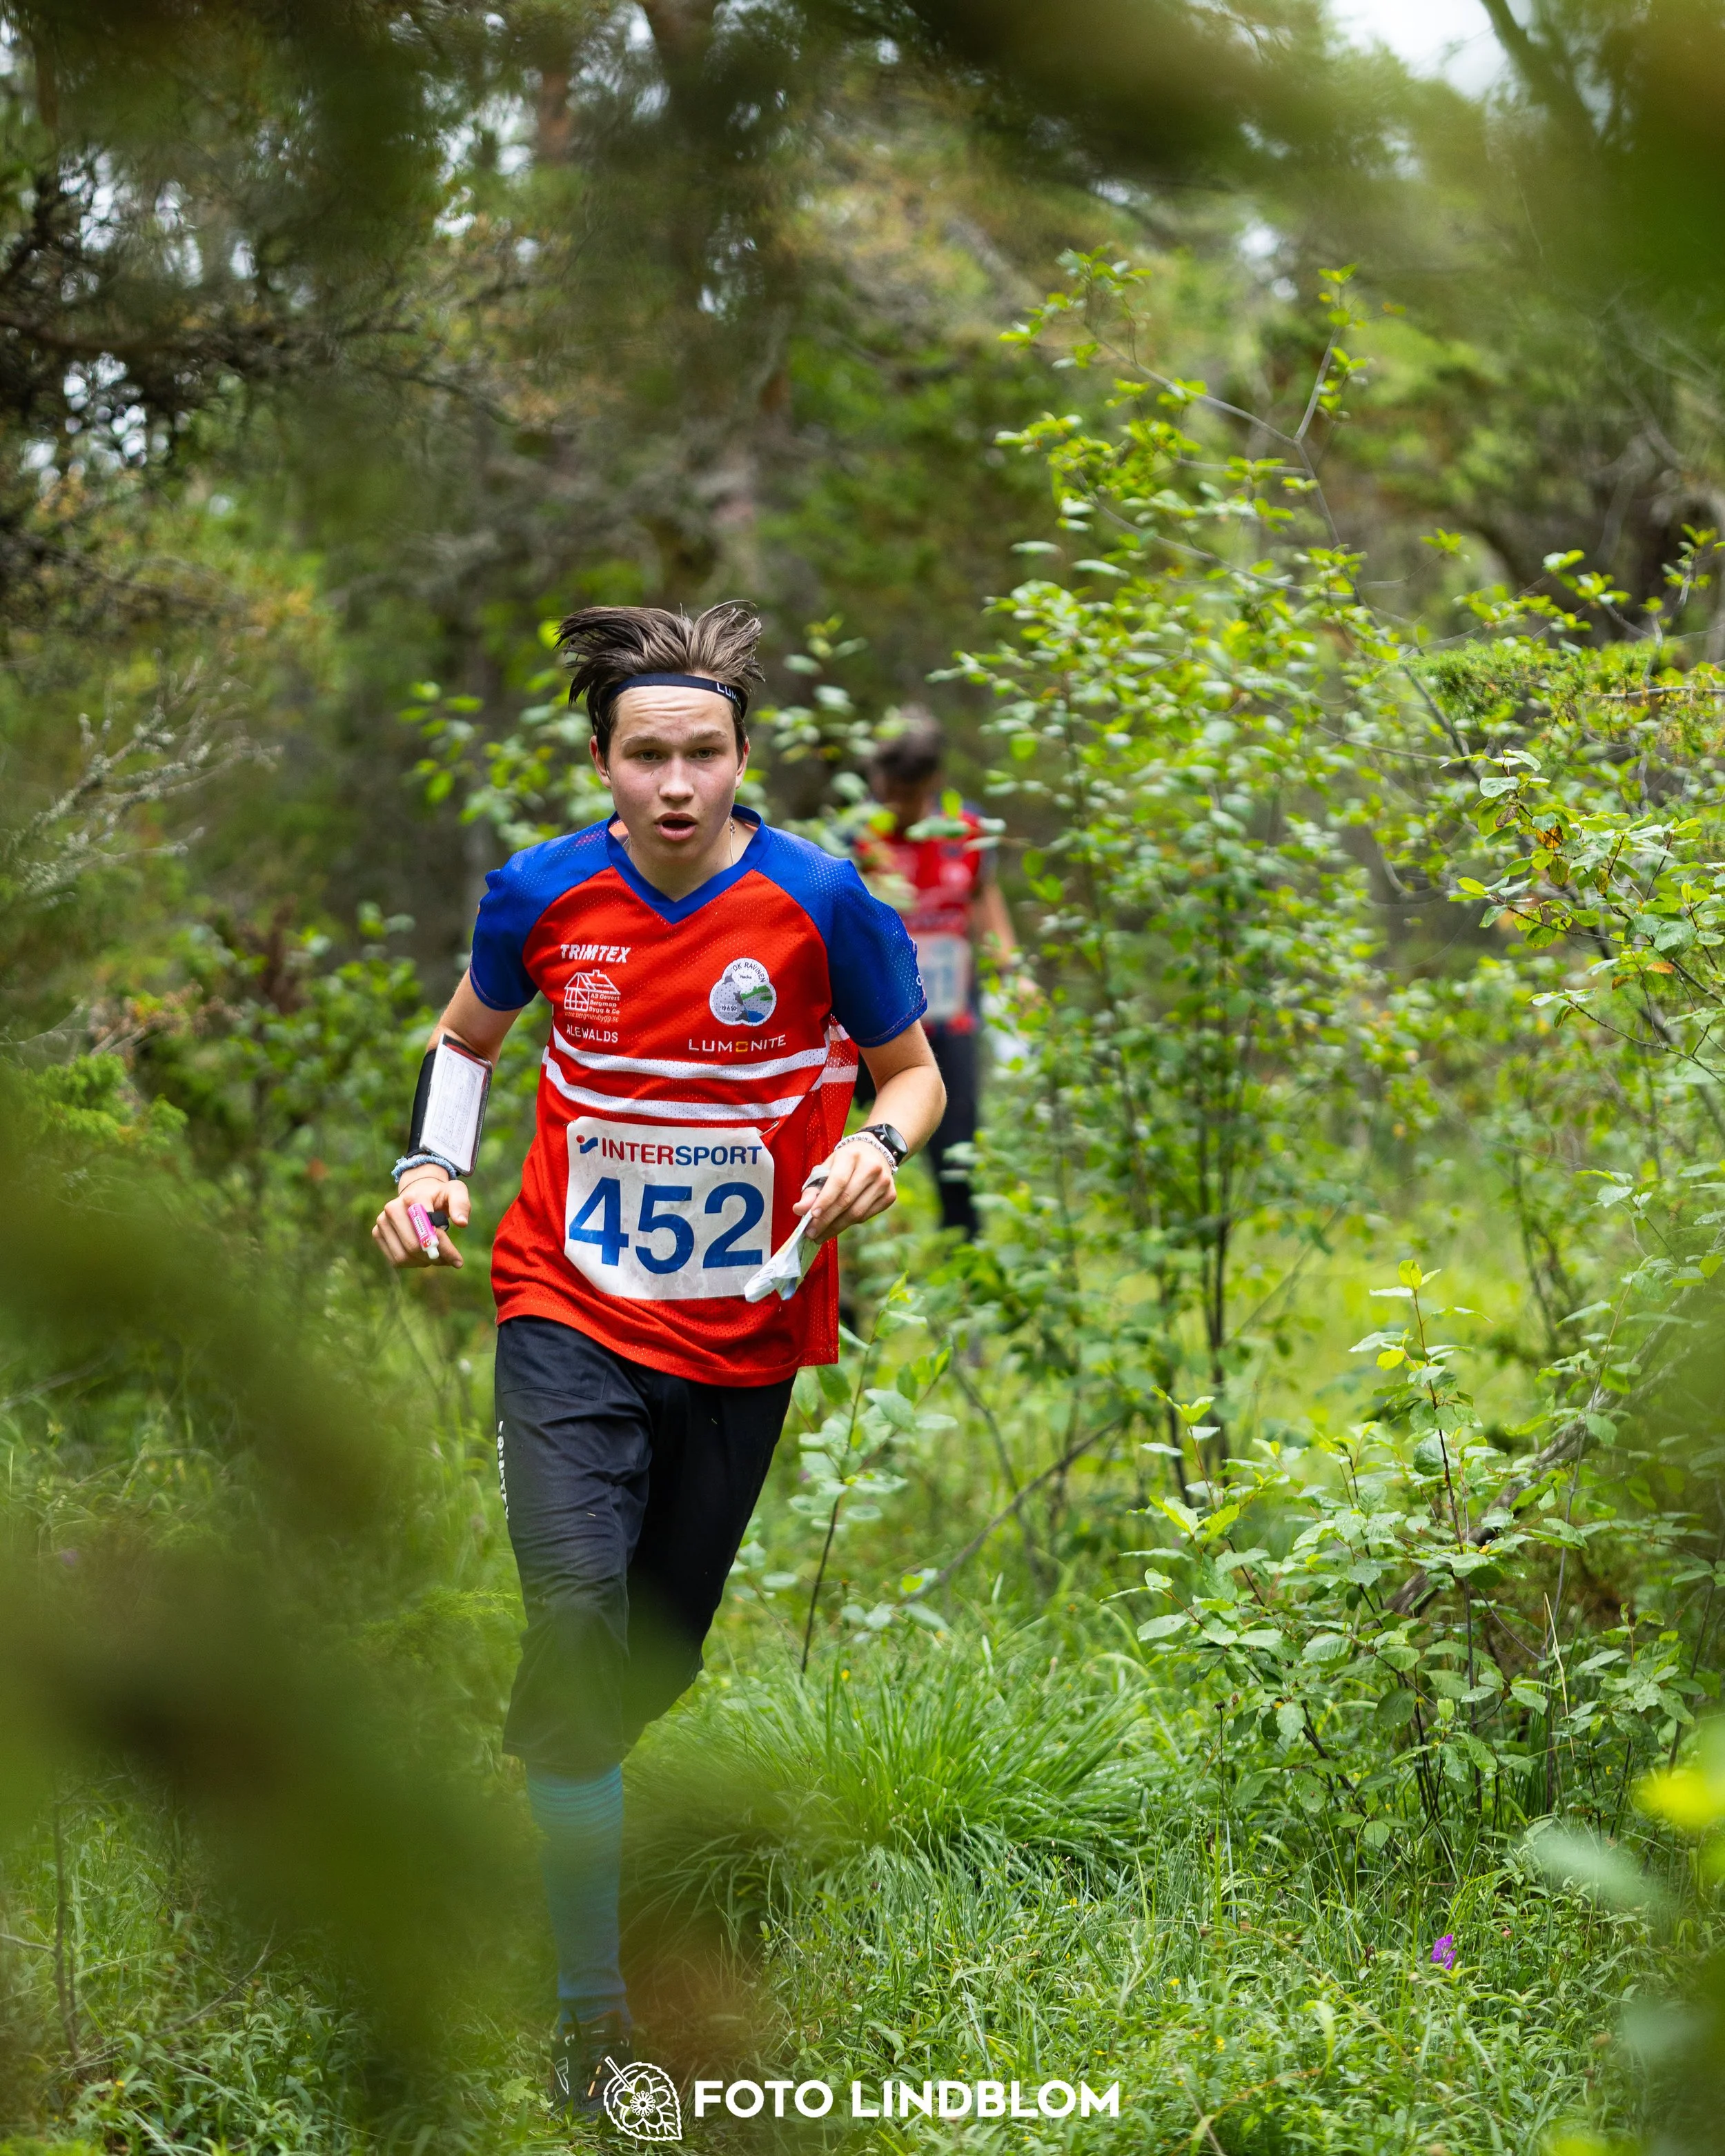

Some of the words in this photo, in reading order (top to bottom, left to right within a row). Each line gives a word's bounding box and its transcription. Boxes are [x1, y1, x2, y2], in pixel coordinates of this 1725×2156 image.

[560, 944, 631, 964] TRIMTEX
[589, 1000, 617, 1008] Bergman
[566, 1024, 618, 1043] ALEWALDS
[689, 1034, 787, 1052] LUMONITE
[602, 1137, 762, 1166] INTERSPORT
[569, 1176, 765, 1275] 452
